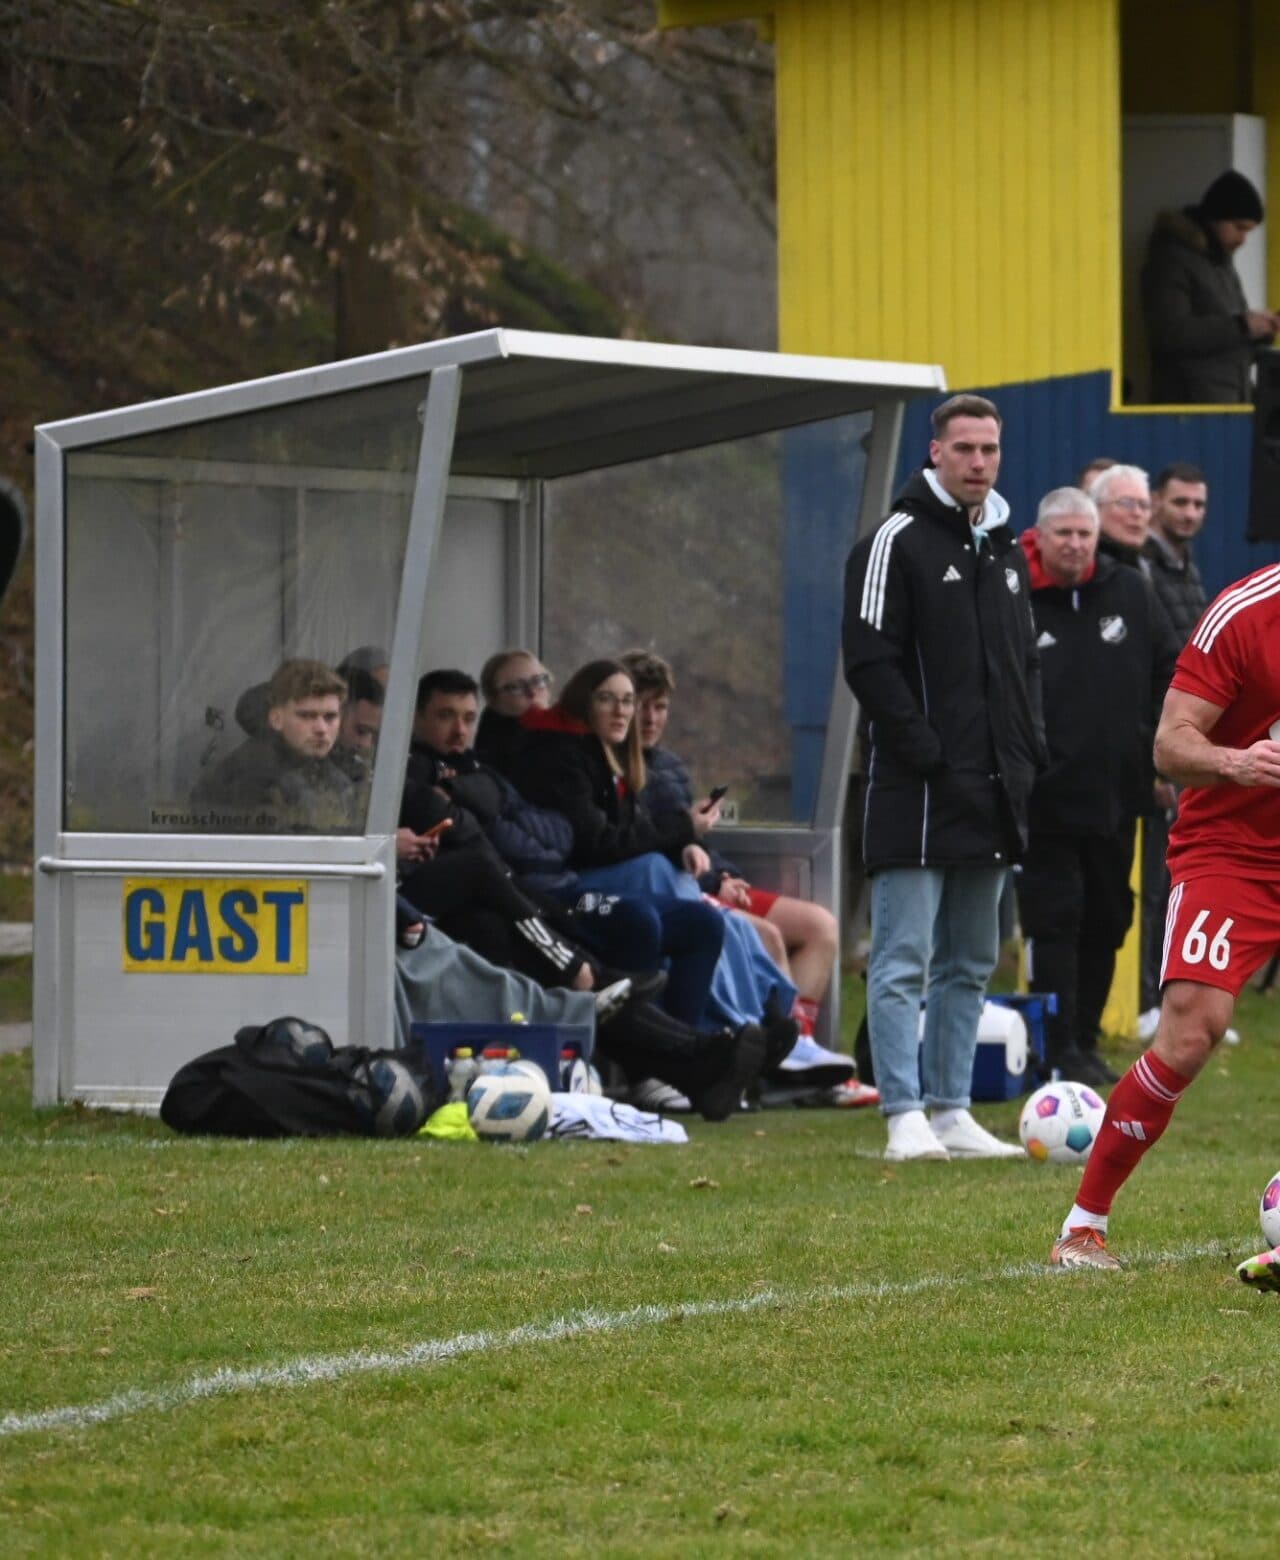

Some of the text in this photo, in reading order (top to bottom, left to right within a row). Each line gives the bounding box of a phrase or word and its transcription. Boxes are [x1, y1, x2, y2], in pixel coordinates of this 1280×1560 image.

[151, 810, 278, 826] kreuschner.de
[125, 887, 304, 963] GAST
[1181, 909, 1235, 971] 66
